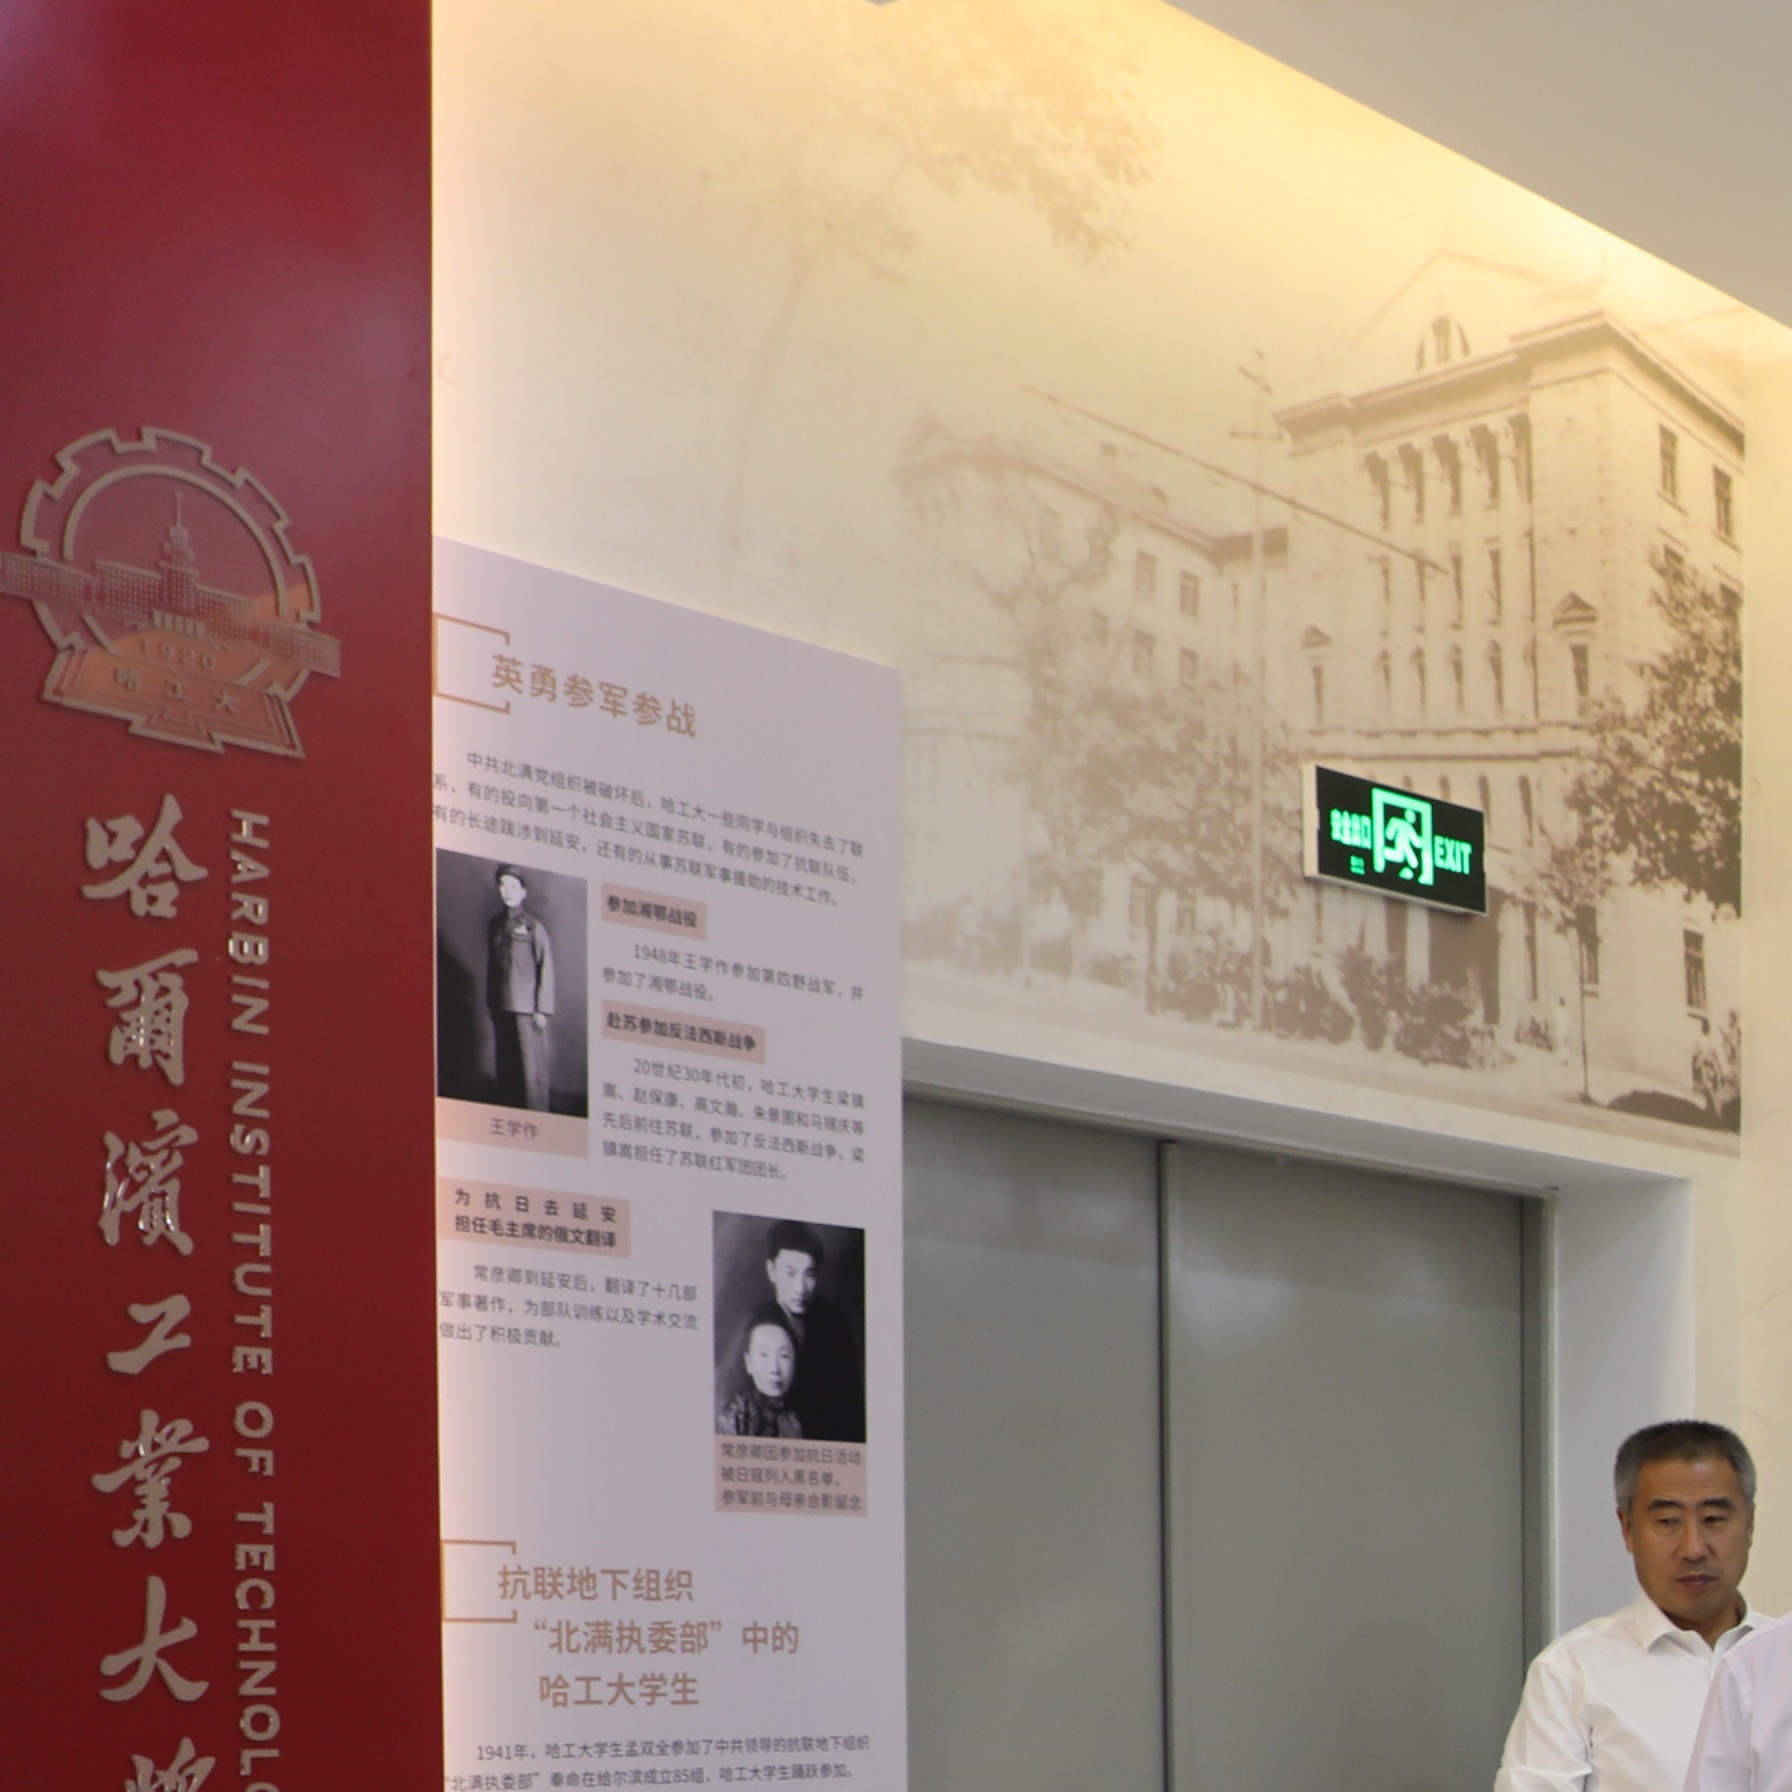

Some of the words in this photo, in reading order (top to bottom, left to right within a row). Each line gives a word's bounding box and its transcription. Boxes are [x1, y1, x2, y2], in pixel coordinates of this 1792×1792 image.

[113, 667, 237, 715] 哈工大
[491, 653, 697, 738] 英勇参军参战
[1434, 835, 1472, 875] EXIT
[229, 808, 271, 1034] HARBIN
[607, 1011, 756, 1053] 赴苏参加反法西斯战争
[490, 1117, 538, 1139] 王学作
[230, 1061, 275, 1376] INSTITUTE
[455, 1214, 616, 1249] 担任毛主席的俄文翻译
[234, 1400, 275, 1478] OF
[499, 1565, 694, 1602] 抗联地下组织
[539, 1672, 700, 1709] 哈工大学生
